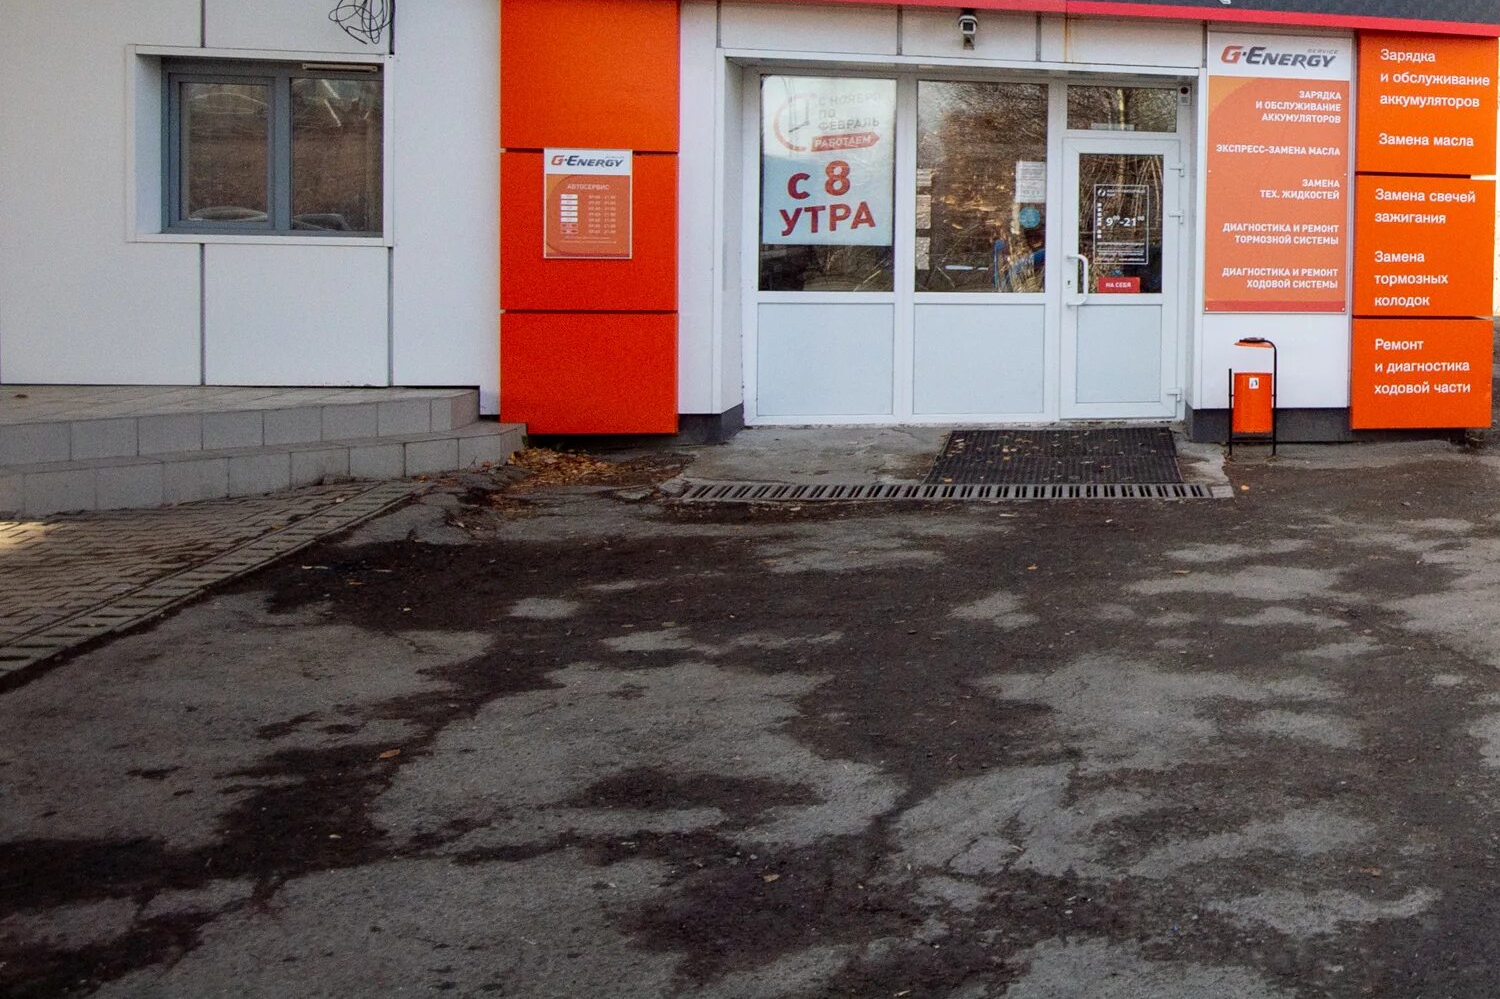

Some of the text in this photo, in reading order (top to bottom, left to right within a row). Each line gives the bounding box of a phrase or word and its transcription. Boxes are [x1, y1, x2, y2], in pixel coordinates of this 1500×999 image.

[1380, 49, 1436, 63] Зарядка
[1380, 71, 1490, 88] и обслуживание
[1298, 90, 1342, 101] ЗАРЯДКА
[1255, 101, 1341, 112] И ОБСЛУЖИВАНИЕ
[1380, 95, 1480, 109] аккумуляторов
[818, 117, 880, 131] ФЕВРАЛЬ
[1261, 113, 1341, 123] АККУМУЛЯТОРОВ
[815, 135, 871, 147] РАБОТАЕМ
[1379, 133, 1474, 147] Замена масла
[1216, 144, 1341, 155] ЭКСПРЕСС-ЗАМЕНА МАСЛА
[787, 160, 850, 199] С 8
[1302, 179, 1340, 188] ЗАМЕНА
[1260, 189, 1340, 200] ТЕХ. ЖИДКОСТЕЙ
[1375, 188, 1476, 203] Замена свечей
[779, 201, 876, 236] УТРА
[1375, 212, 1446, 224] зажигания
[1222, 223, 1339, 233] ДИАГНОСТИКА И РЕМОНТ
[1235, 234, 1339, 245] ТОРМОЗНОЙ СИСТЕМЫ
[1375, 250, 1425, 263] Замена
[1222, 267, 1338, 277] ДИАГНОСТИКА И РЕМОНТ
[1247, 278, 1338, 289] ХОДОВОЙ СИСТЕМЫ
[1375, 274, 1448, 287] тормозных
[1375, 295, 1430, 308] колодок
[1375, 339, 1424, 350] Ремонт
[1375, 361, 1470, 374] и диагностика
[1375, 382, 1470, 395] ходовой части
